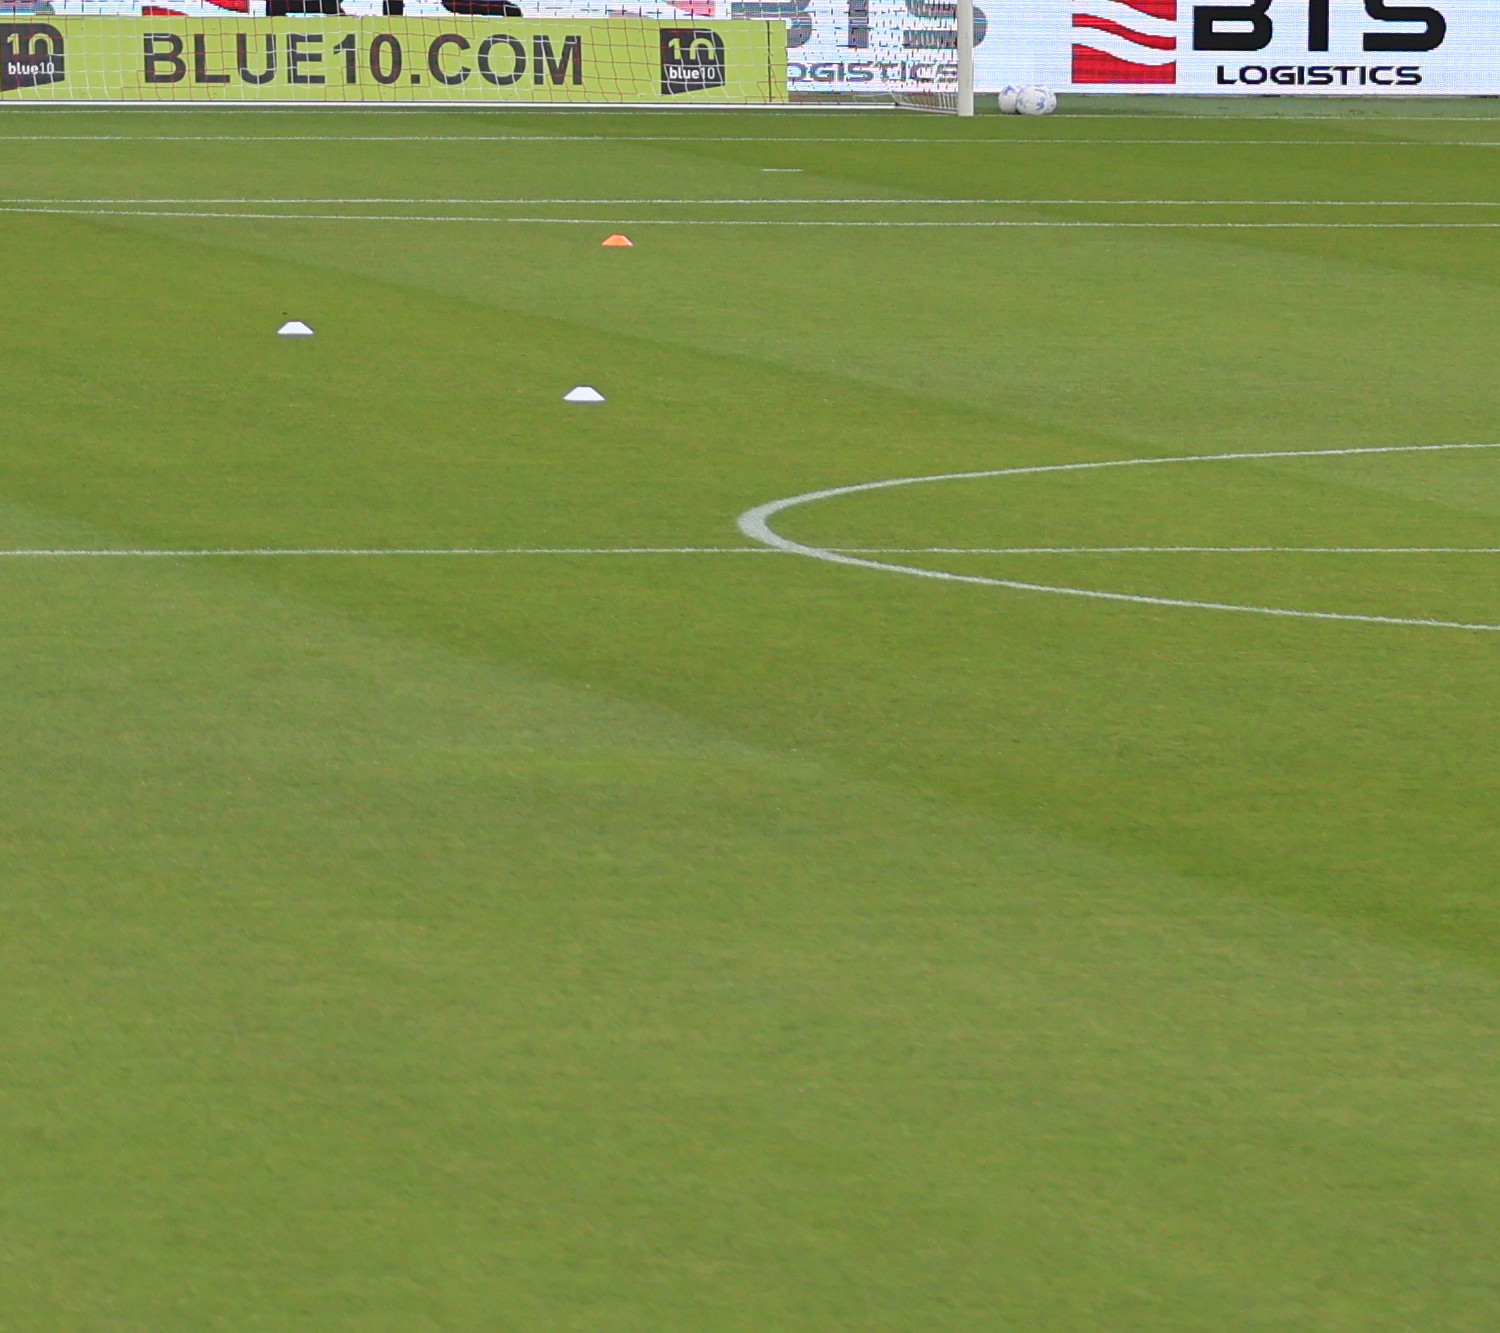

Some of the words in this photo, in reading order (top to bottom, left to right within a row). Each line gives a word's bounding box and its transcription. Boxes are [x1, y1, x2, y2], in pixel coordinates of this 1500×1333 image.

[7, 61, 55, 75] blue10
[143, 33, 582, 86] BLUE10.COM
[668, 66, 716, 80] blue10
[786, 62, 959, 83] OGISTICS
[1216, 65, 1423, 87] LOGISTICS
